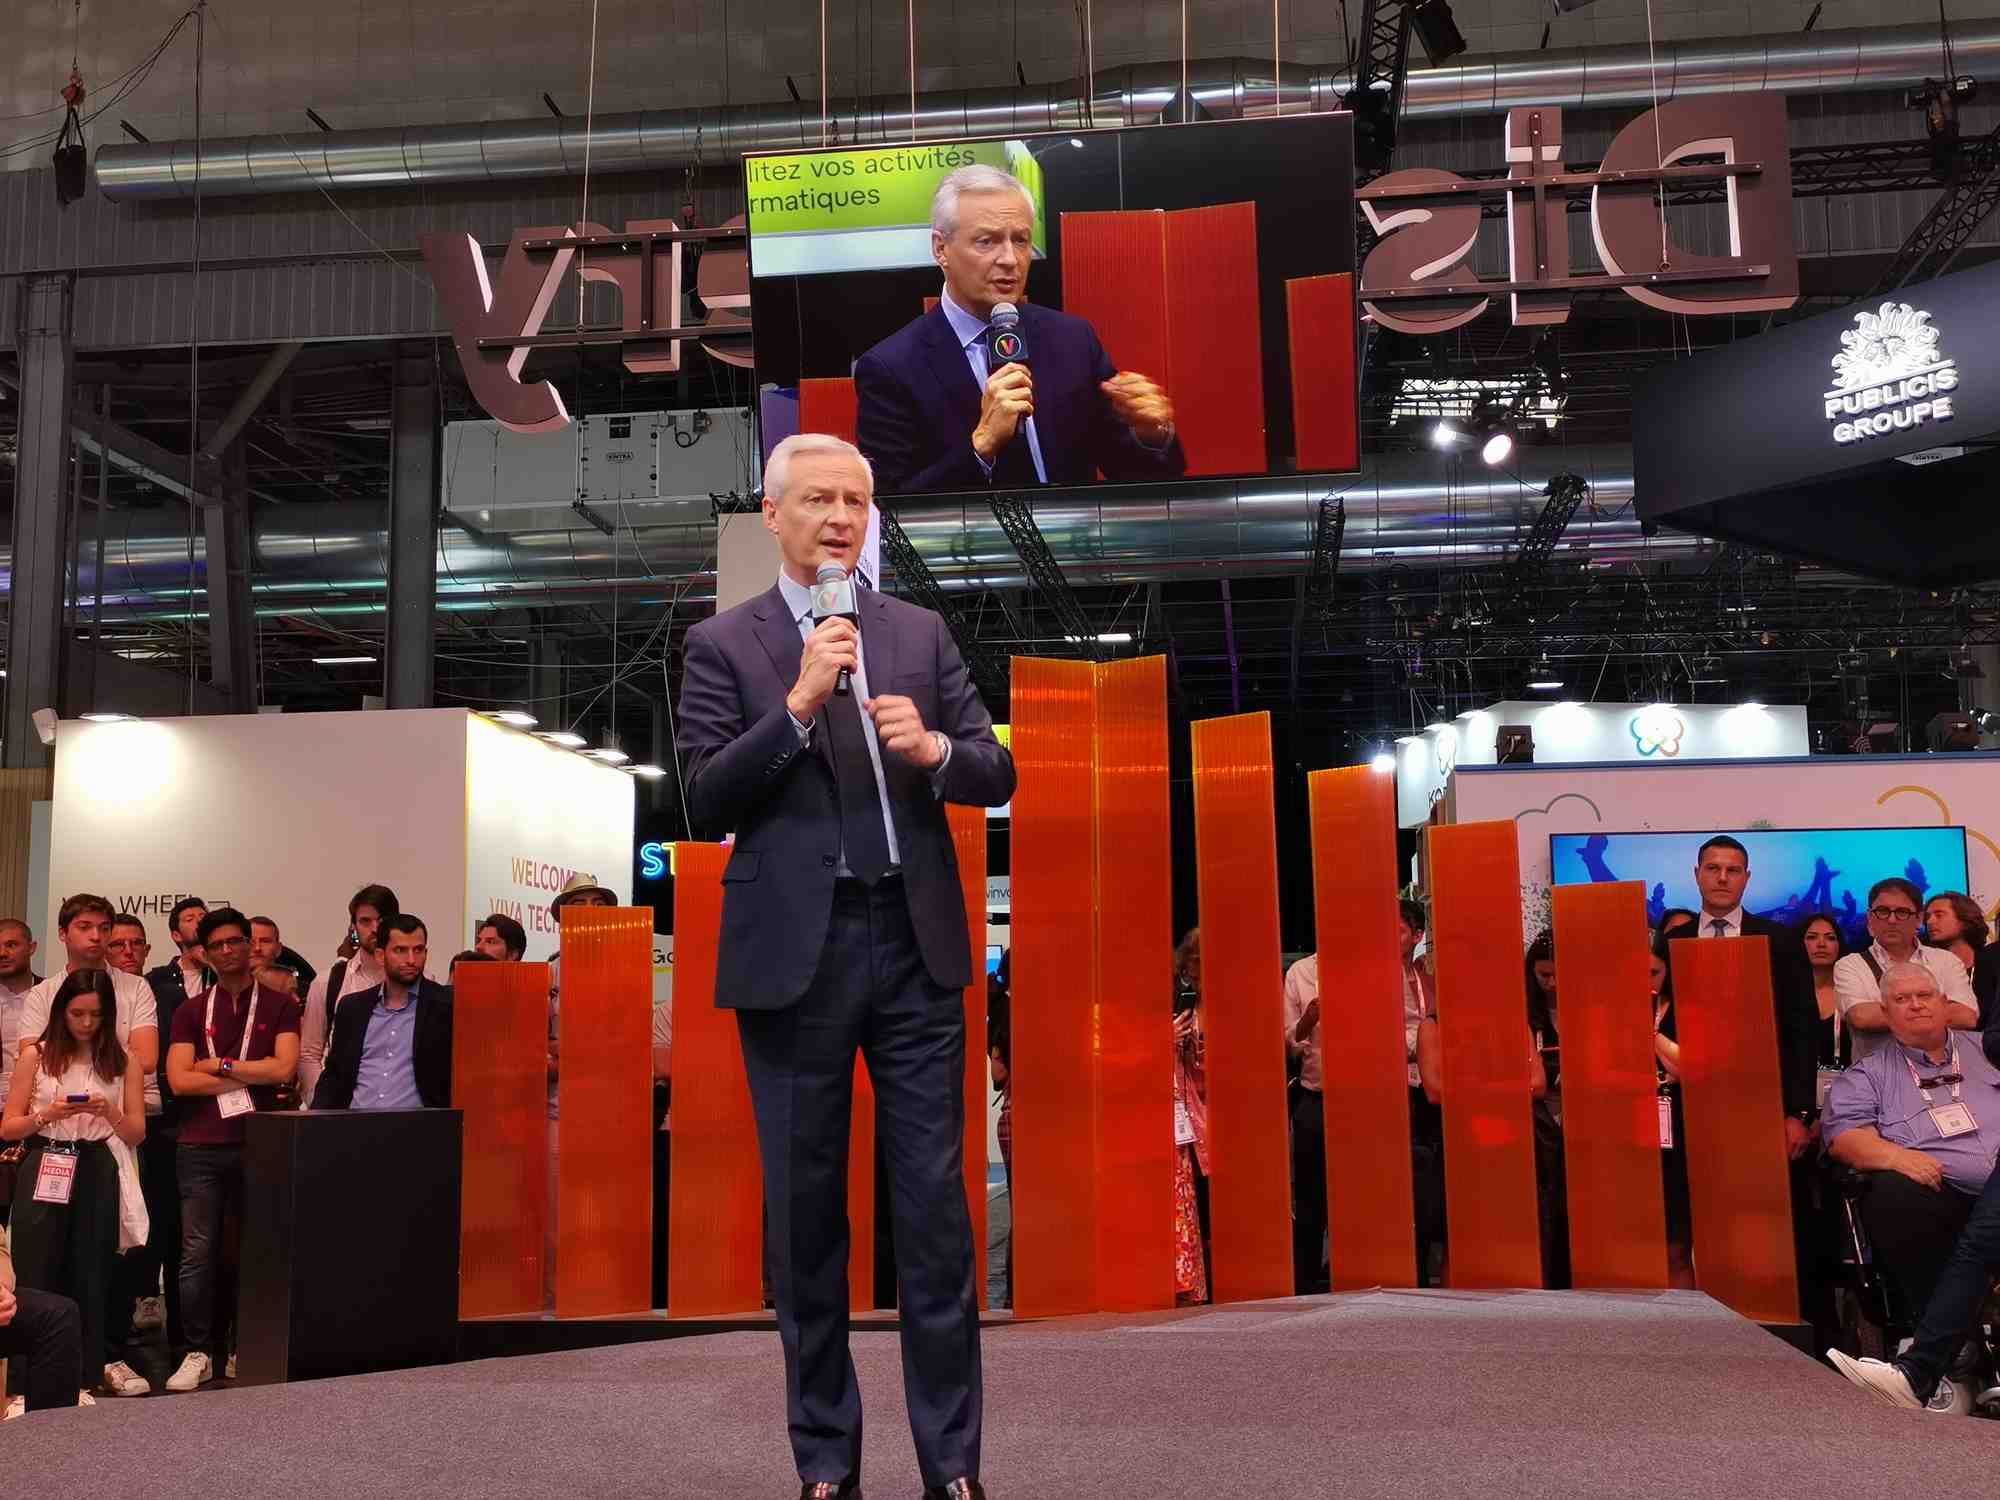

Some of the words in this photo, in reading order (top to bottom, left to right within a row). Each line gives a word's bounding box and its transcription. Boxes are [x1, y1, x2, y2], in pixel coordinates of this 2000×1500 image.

[809, 159, 856, 178] vos
[864, 147, 975, 175] activités
[750, 187, 881, 214] rmatiques
[1824, 367, 1959, 419] PUBLICIS
[1833, 396, 1955, 443] GROUPE
[512, 856, 578, 892] WELCOM
